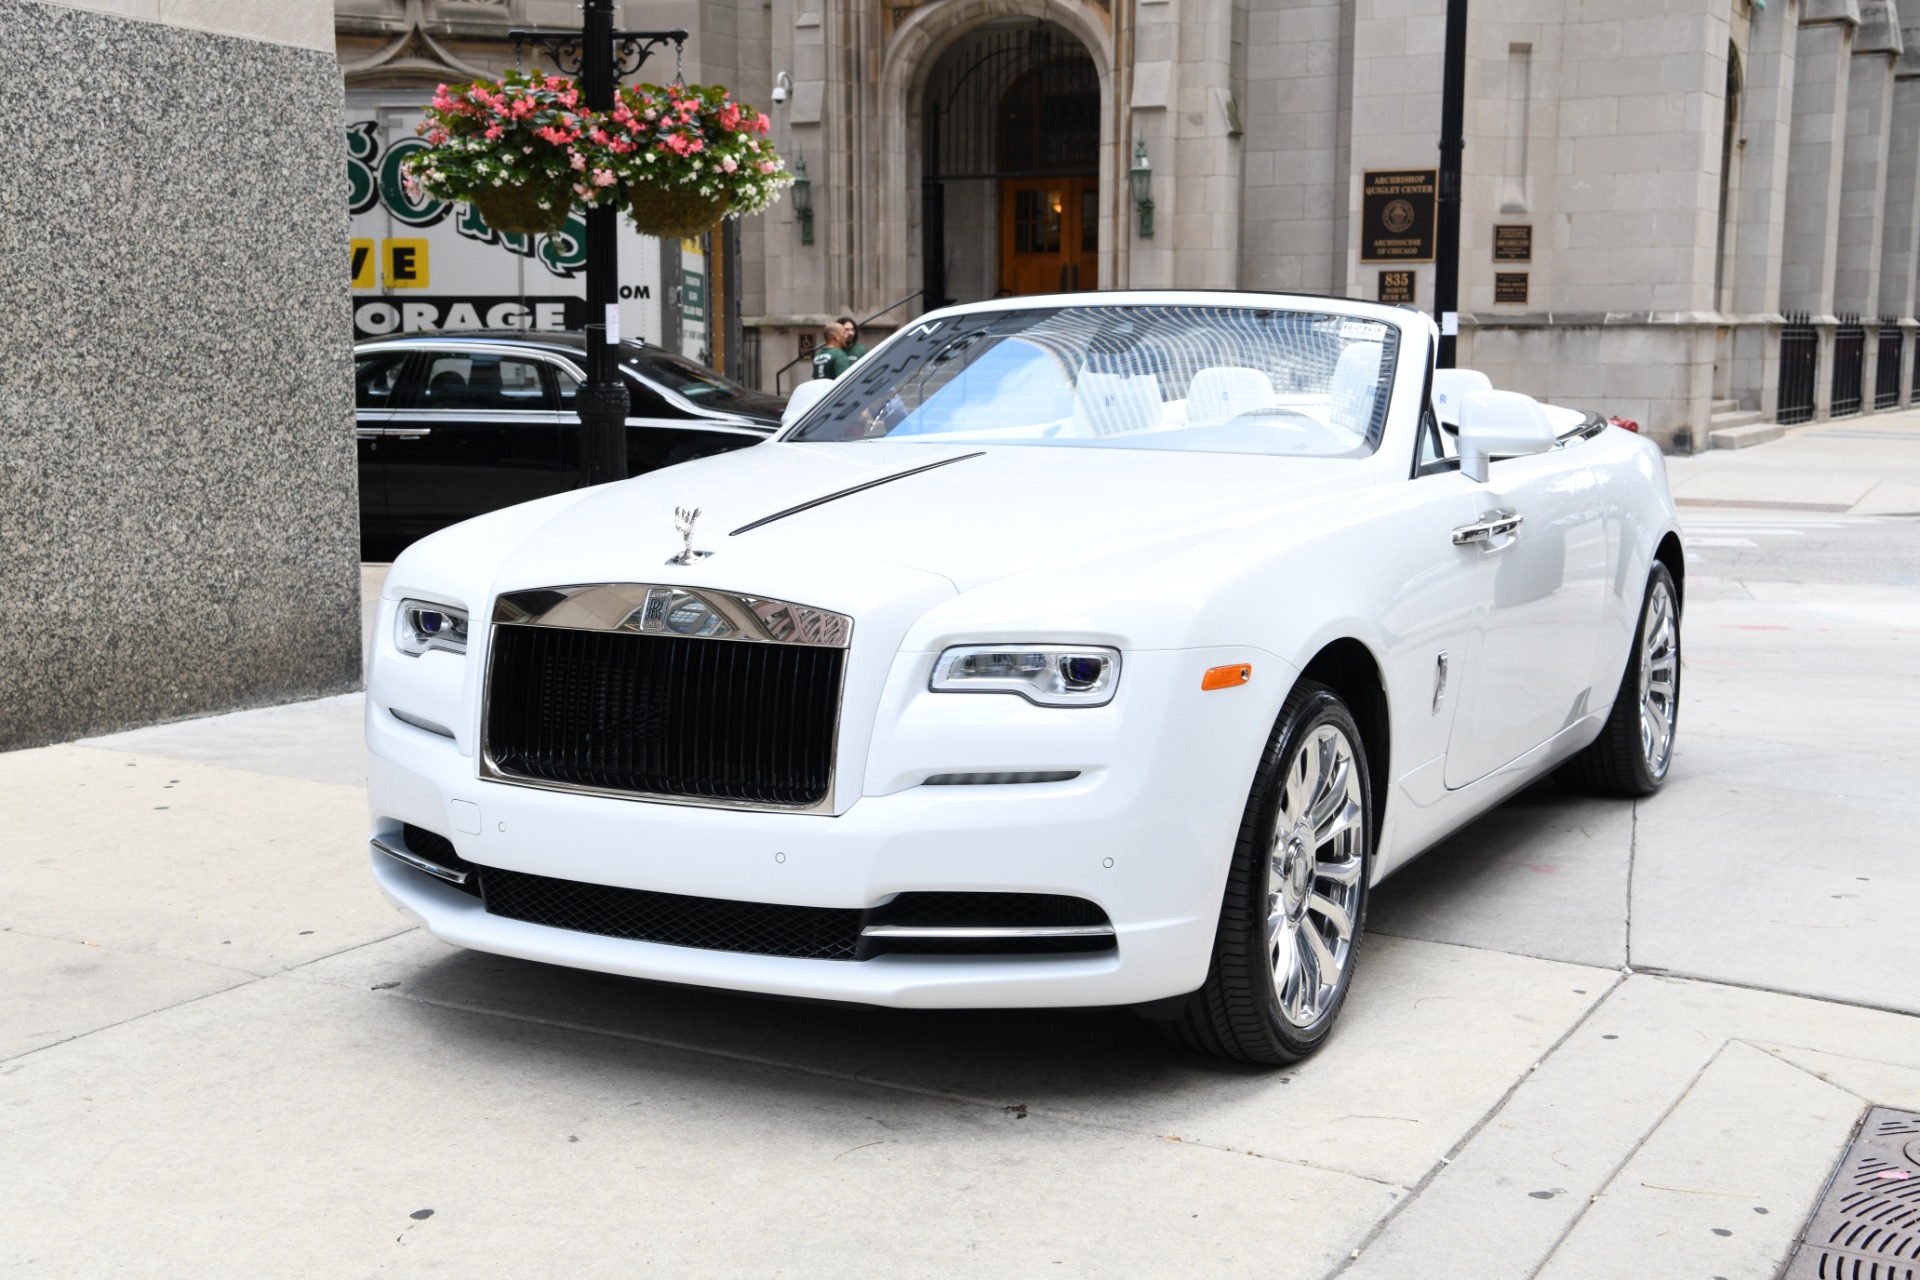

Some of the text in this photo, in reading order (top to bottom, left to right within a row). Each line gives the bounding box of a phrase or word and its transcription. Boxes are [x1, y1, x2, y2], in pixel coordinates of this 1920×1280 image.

[1374, 175, 1426, 185] ARCHBISHOP
[1365, 185, 1433, 196] QUIGLEY CENTER
[1374, 239, 1422, 247] ARCHDIOCESE
[1387, 247, 1418, 255] CHICAGO
[1385, 273, 1409, 287] 835
